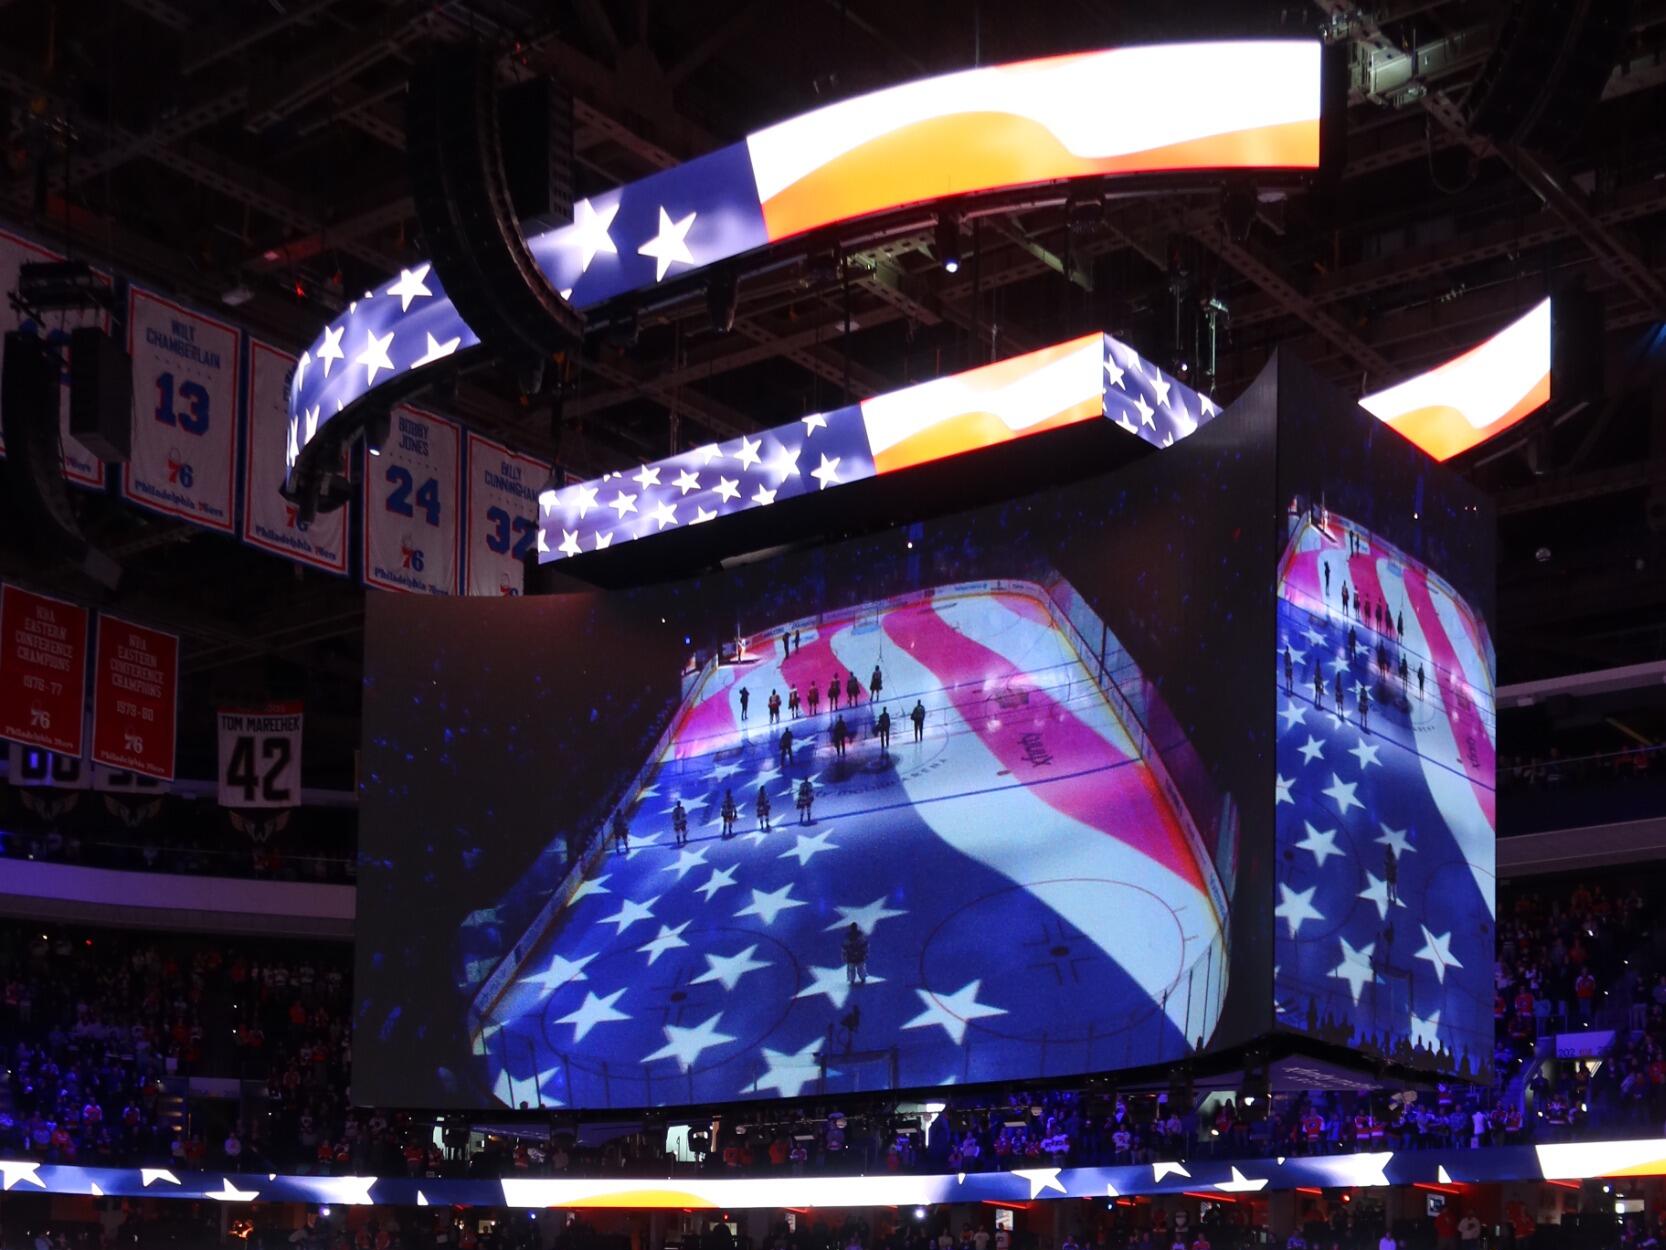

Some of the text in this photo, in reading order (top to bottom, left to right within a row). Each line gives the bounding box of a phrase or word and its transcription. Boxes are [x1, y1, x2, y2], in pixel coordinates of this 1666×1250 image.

[146, 327, 221, 369] CHAMBERLAIN
[155, 372, 210, 436] 13
[399, 435, 429, 457] JONES
[167, 459, 194, 488] 76
[501, 461, 522, 481] BILLY
[386, 464, 441, 528] 24
[486, 505, 539, 562] 32
[402, 547, 425, 572] 76
[24, 617, 68, 641] EASTERN
[15, 629, 75, 659] CONFERENCE
[117, 644, 158, 668] EASTERN
[16, 645, 71, 672] CHAMPIONS
[109, 657, 166, 685] CONFERENCE
[111, 672, 163, 698] CHAMPIONS
[30, 708, 51, 729] 76
[221, 715, 243, 731] TOM
[124, 732, 144, 754] 76
[226, 736, 290, 801] 42
